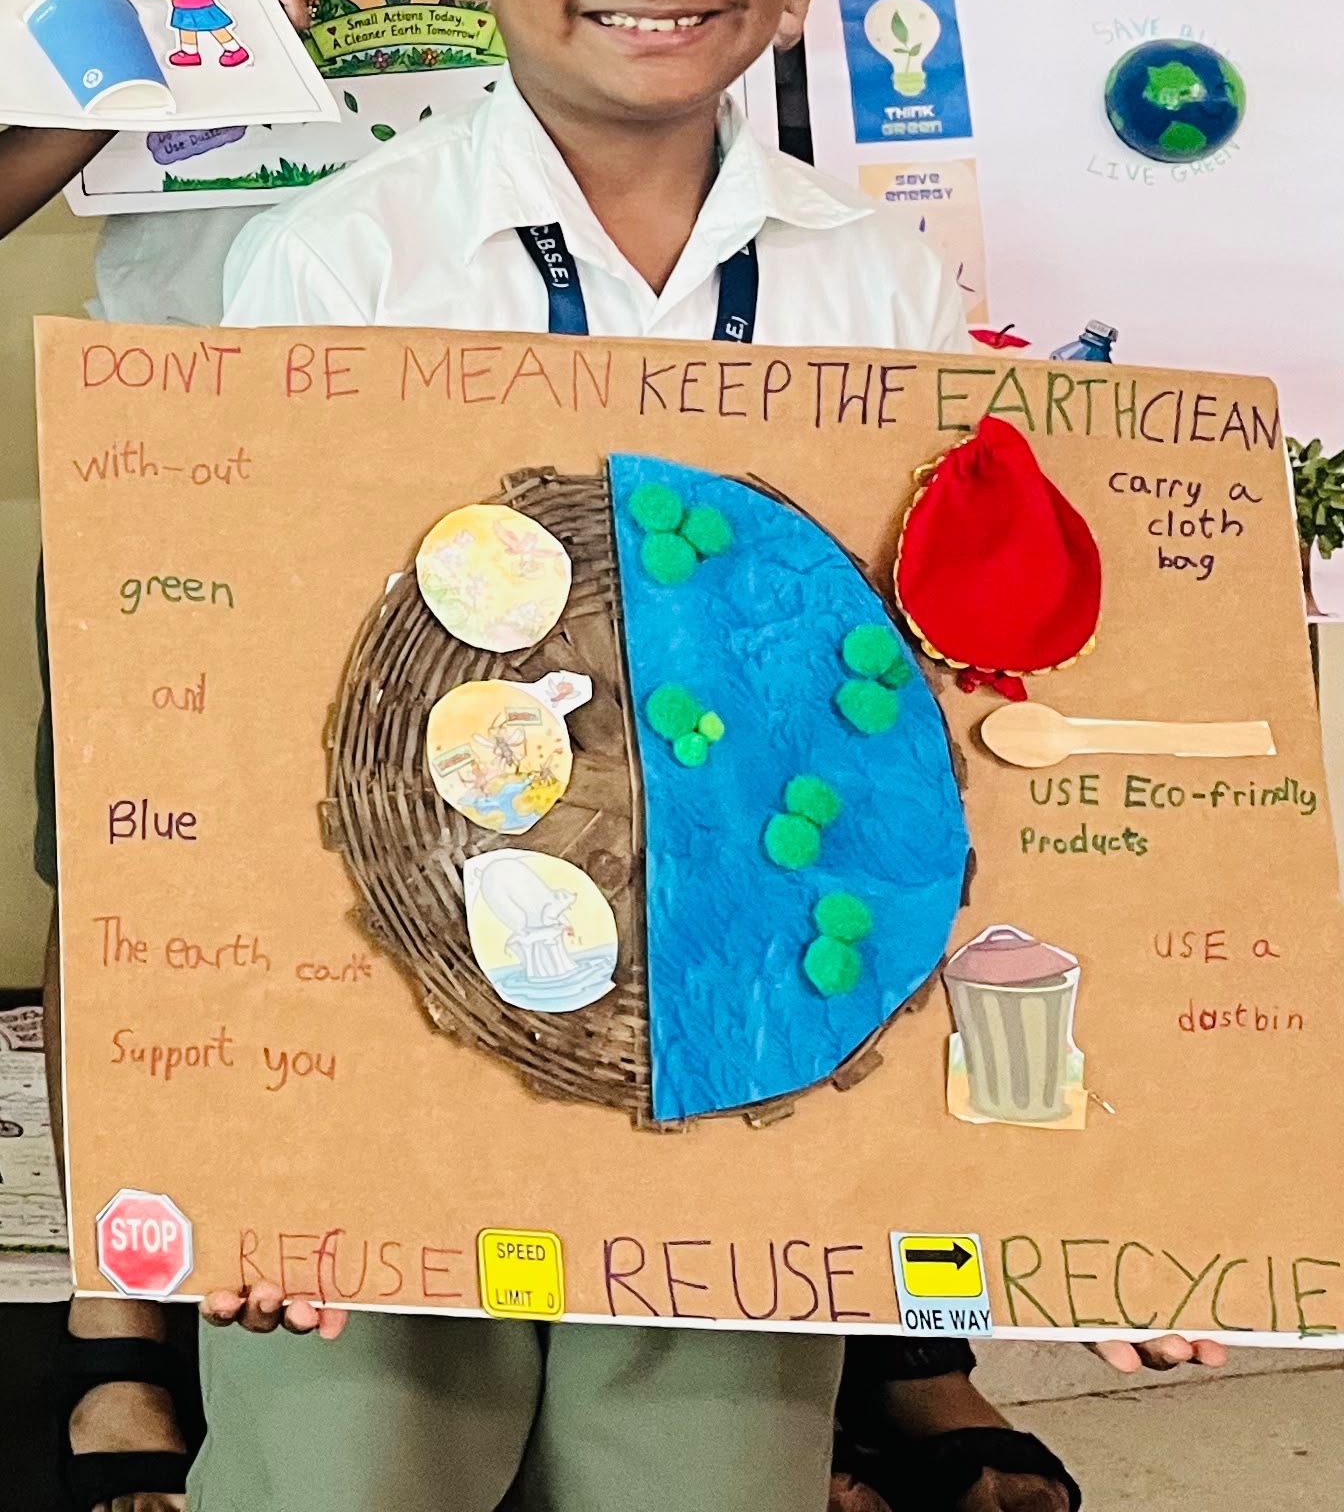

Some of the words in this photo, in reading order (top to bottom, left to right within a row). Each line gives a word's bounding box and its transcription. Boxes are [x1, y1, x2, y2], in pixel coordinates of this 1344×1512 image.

[347, 14, 378, 31] Small
[384, 10, 424, 23] Actions
[429, 10, 465, 27] Today,
[82, 341, 242, 397] DON'T
[286, 343, 366, 402] BE
[402, 346, 613, 412] MEAN
[639, 357, 792, 422] KEEP
[808, 361, 918, 428] THE
[936, 367, 1140, 442] EARTH
[1108, 469, 1202, 508] carry
[1228, 481, 1263, 504] a
[1148, 506, 1245, 538] cloth
[1158, 547, 1216, 581] bag
[119, 573, 234, 616] green
[1030, 775, 1100, 807] USE
[107, 799, 198, 845] Blue
[1020, 823, 1149, 856] Products
[1154, 930, 1229, 963] USE
[1253, 939, 1281, 958] a
[111, 1027, 234, 1082] Support
[262, 1045, 336, 1092] you
[110, 1218, 178, 1255] STOP
[495, 1242, 546, 1263] SPEED
[603, 1236, 872, 1321] REUSE
[494, 1289, 535, 1309] LIMIT
[905, 1308, 947, 1332] ONE
[950, 1309, 992, 1333] WAY
